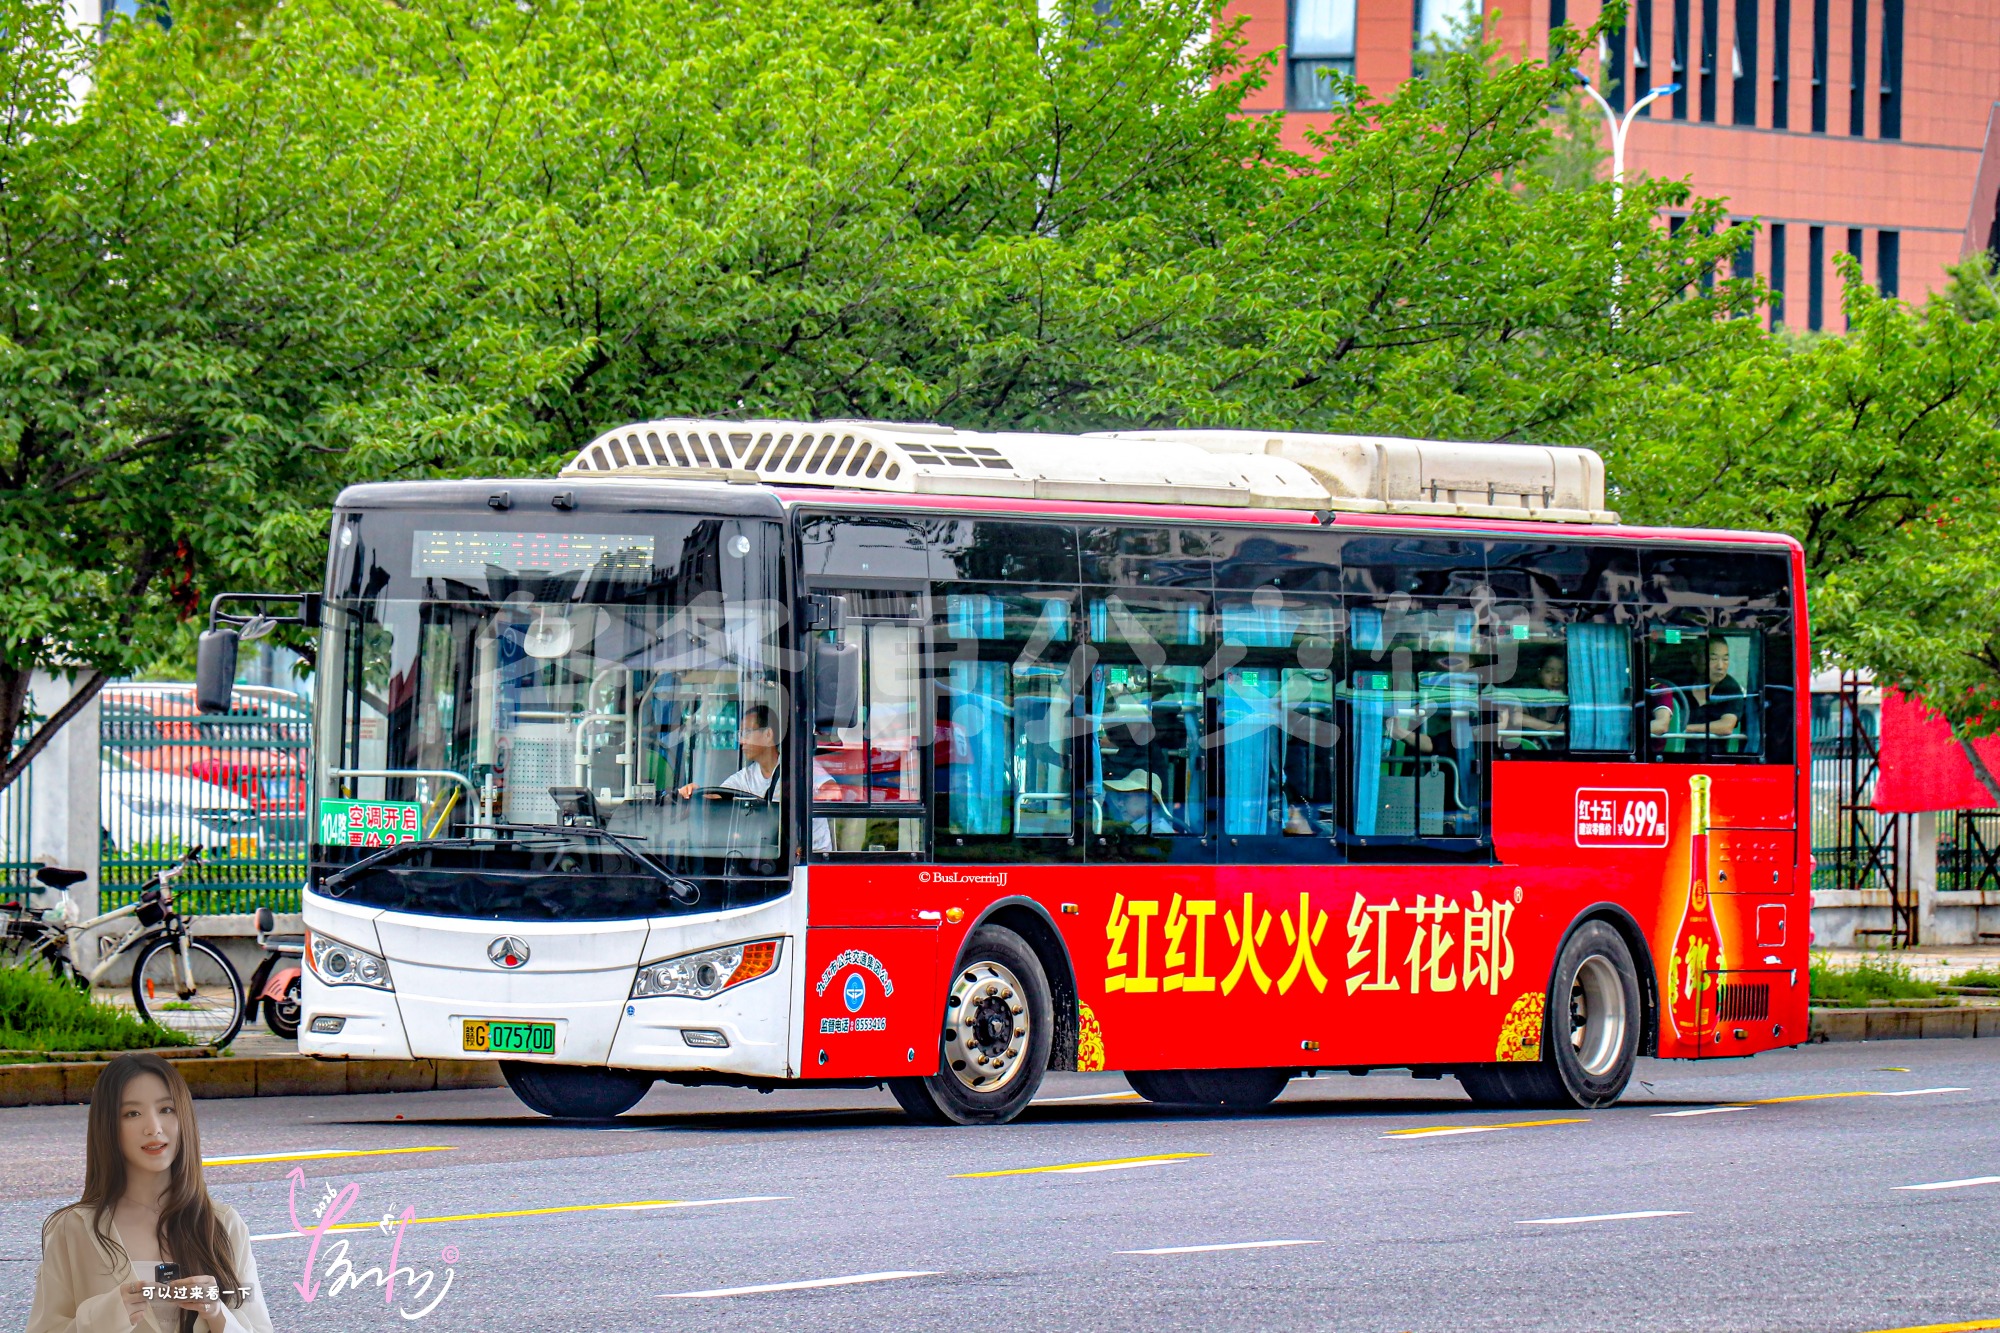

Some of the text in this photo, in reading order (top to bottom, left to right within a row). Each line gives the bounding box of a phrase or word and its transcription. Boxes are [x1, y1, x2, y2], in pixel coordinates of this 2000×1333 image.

[348, 803, 418, 831] 空调开启
[1578, 799, 1613, 822] 红十五
[1104, 891, 1330, 997] 红红火火
[815, 948, 895, 998] 九江市公共交通集团公司
